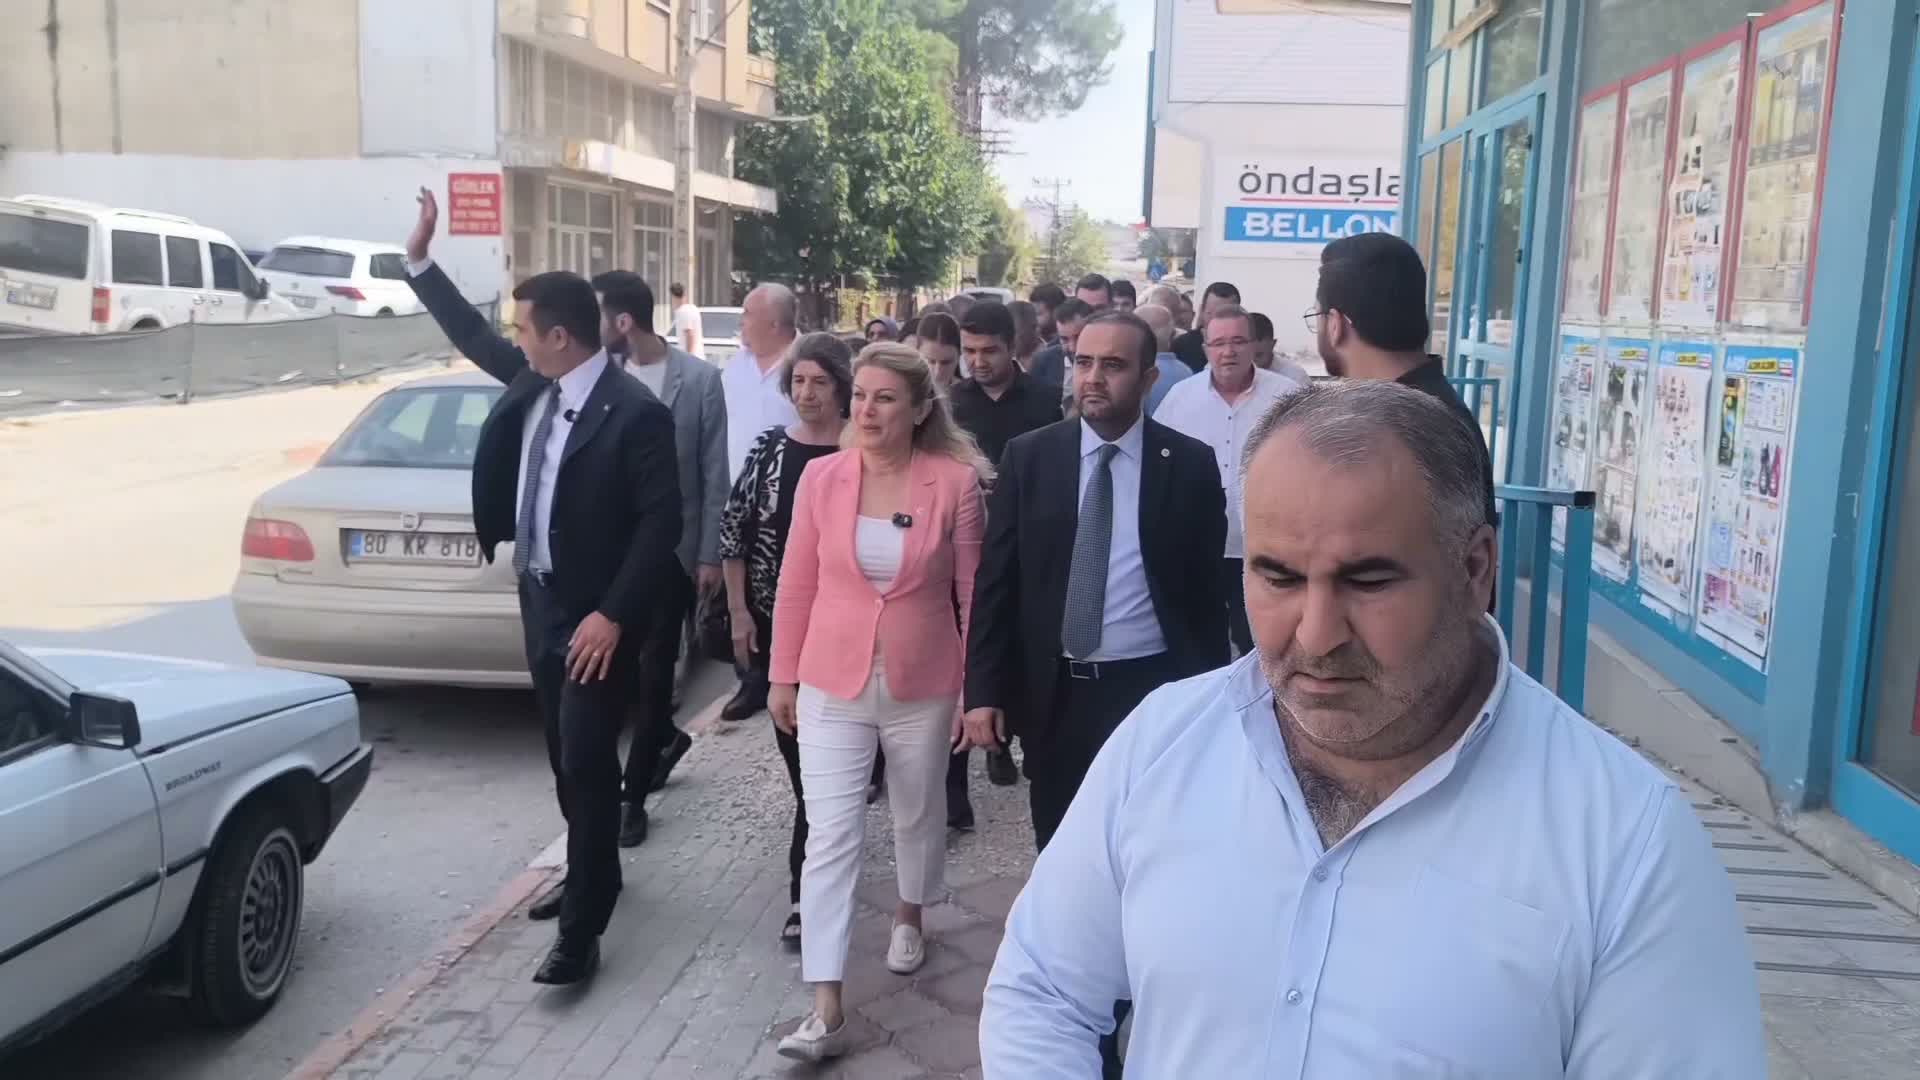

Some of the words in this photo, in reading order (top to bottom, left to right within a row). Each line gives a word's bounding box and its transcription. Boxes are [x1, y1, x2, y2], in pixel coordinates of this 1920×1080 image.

[1239, 164, 1400, 204] öndaşla
[364, 533, 387, 554] 80
[403, 534, 426, 556] KR
[441, 535, 476, 558] 818
